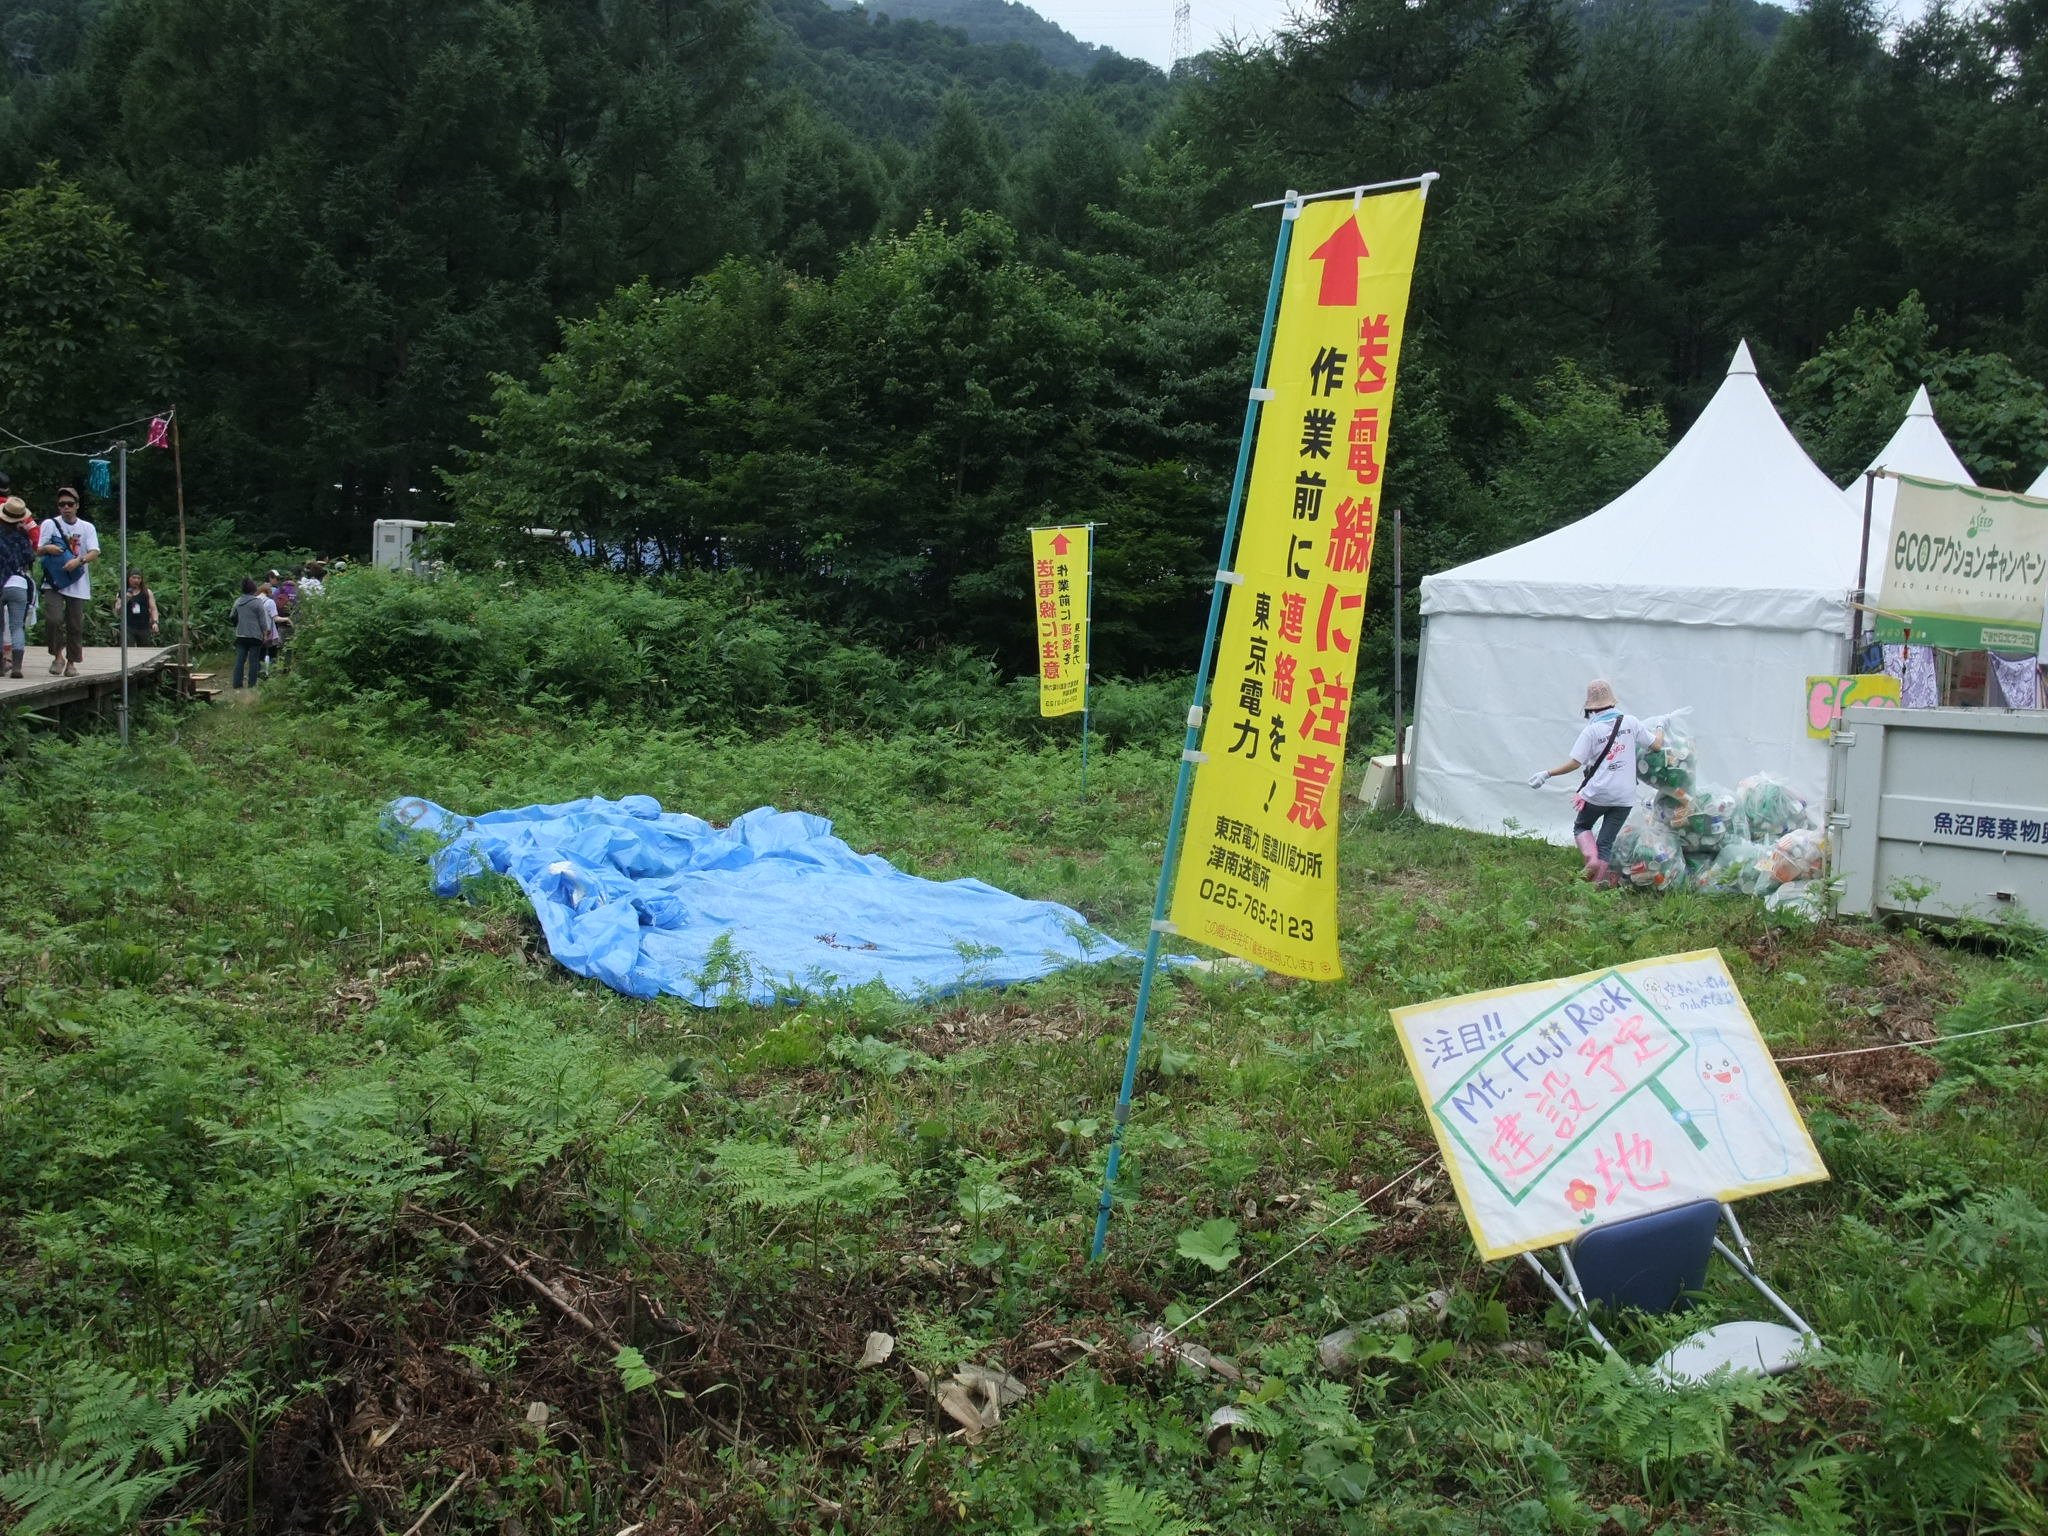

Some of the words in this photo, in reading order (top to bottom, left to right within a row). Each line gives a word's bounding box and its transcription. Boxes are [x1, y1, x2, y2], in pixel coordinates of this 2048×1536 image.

[1287, 313, 1390, 831] 送電線に注意
[1894, 530, 2047, 586] ecoアクションキャンペーン
[1228, 592, 1270, 759] 東京電力
[1206, 844, 1271, 893] 津南送電所
[1214, 815, 1260, 854] 東京電力
[1199, 878, 1314, 942] 025-765-2123
[1422, 1011, 1506, 1069] 注目!!
[1450, 1070, 1514, 1124] Mt.
[1502, 1021, 1573, 1082] Fuji
[1563, 980, 1633, 1037] Rock
[1487, 1013, 1670, 1179] 建設予定
[1593, 1131, 1672, 1206] 地
